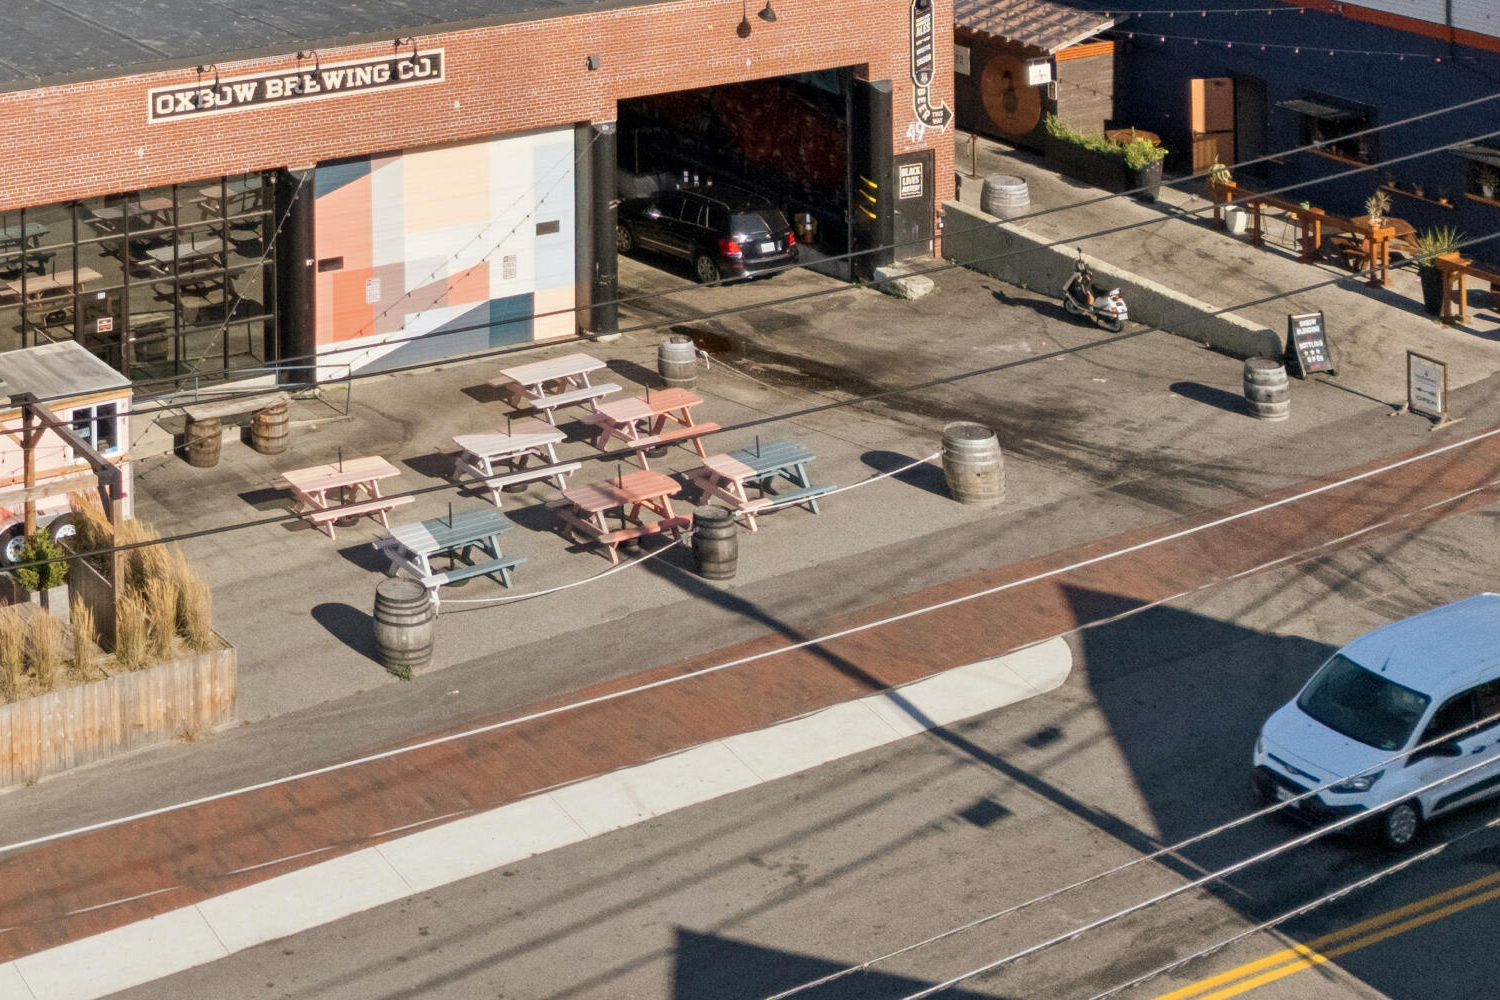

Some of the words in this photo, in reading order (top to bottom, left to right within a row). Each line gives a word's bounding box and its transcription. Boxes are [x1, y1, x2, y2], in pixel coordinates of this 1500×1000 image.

[156, 82, 258, 115] OXBOW
[265, 63, 390, 99] BREWING
[397, 58, 438, 80] CO.
[917, 88, 931, 121] BEER
[932, 110, 943, 118] THIS
[932, 117, 943, 125] WAY
[906, 121, 925, 143] 49
[901, 166, 920, 177] BLACK
[902, 176, 920, 186] LIVES
